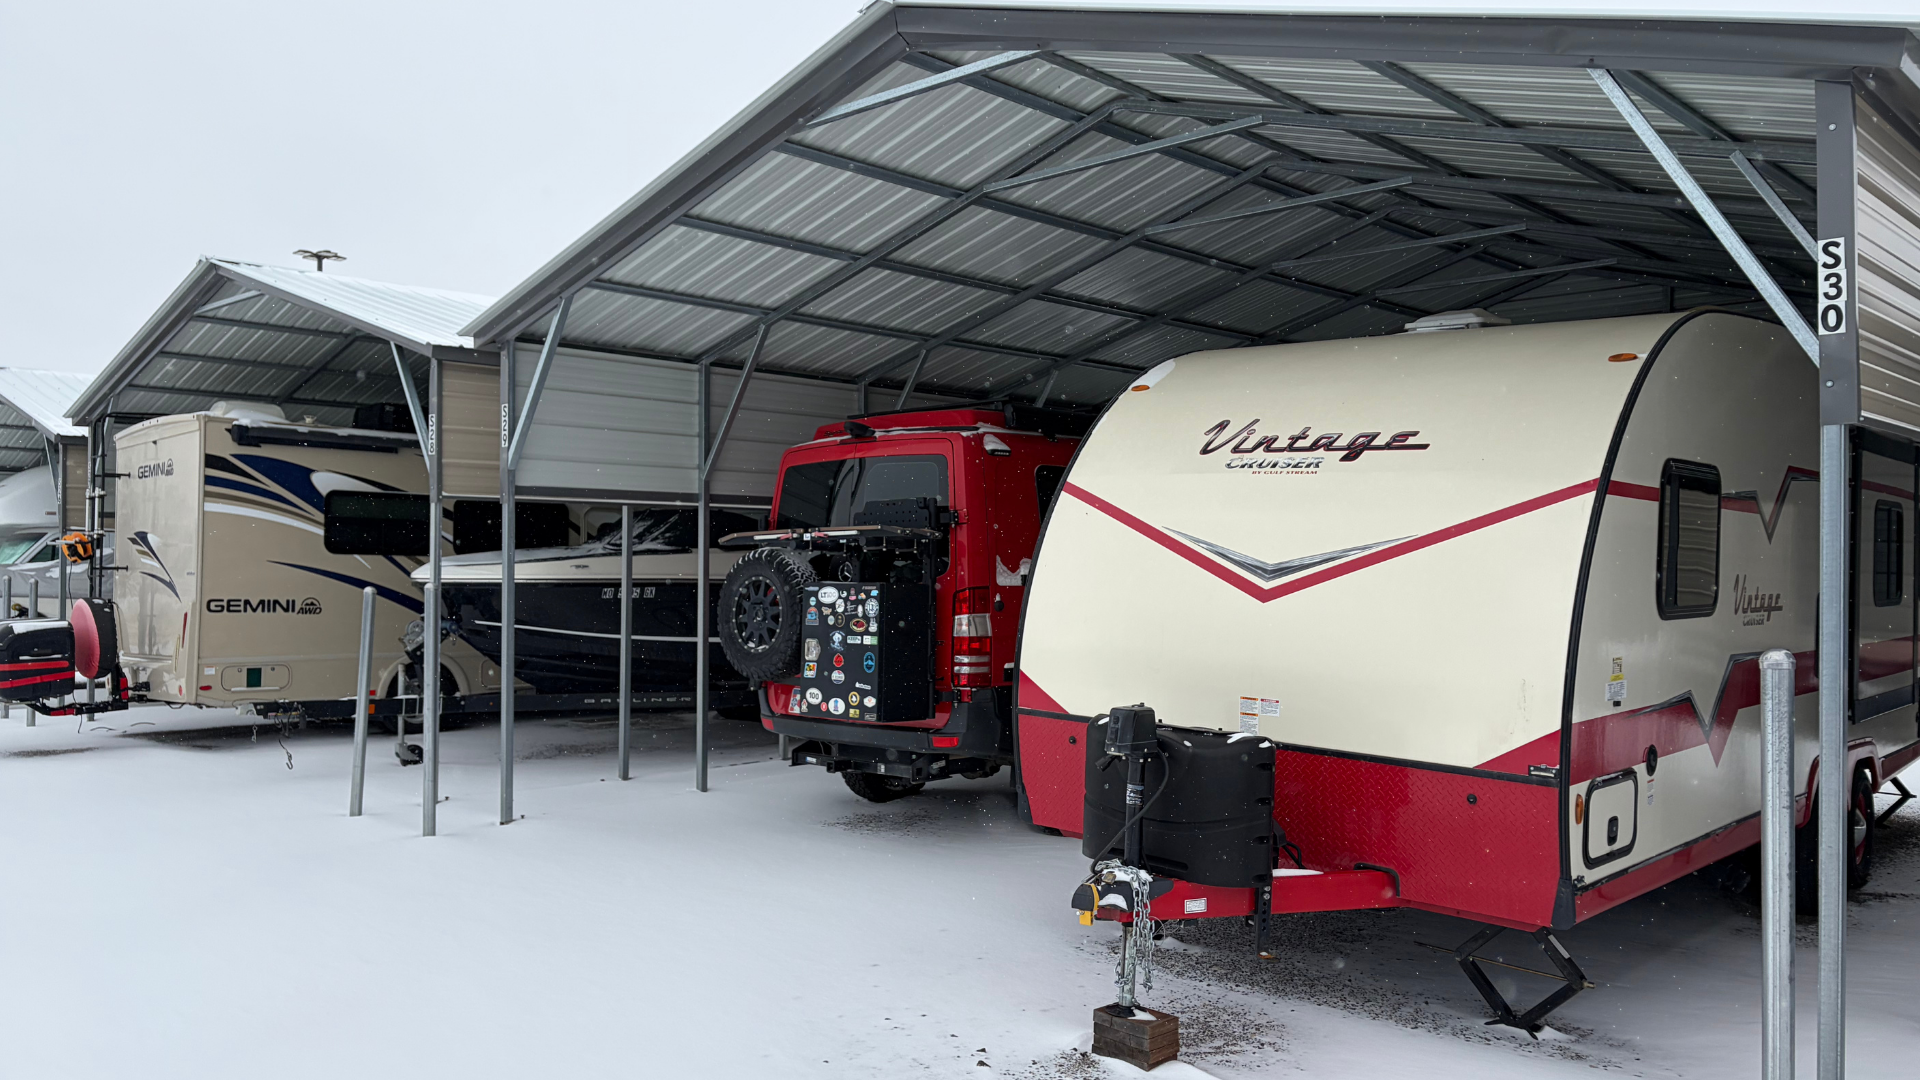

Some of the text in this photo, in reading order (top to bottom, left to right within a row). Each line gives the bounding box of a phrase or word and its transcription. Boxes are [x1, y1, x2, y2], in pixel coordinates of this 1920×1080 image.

[1820, 240, 1843, 333] S30
[1199, 418, 1430, 462] Vintage
[137, 461, 166, 480] GEMINI
[1225, 456, 1325, 469] CRUISER
[206, 598, 323, 615] GEMINI AWD
[1733, 573, 1783, 622] Vintage
[809, 691, 820, 700] 100
